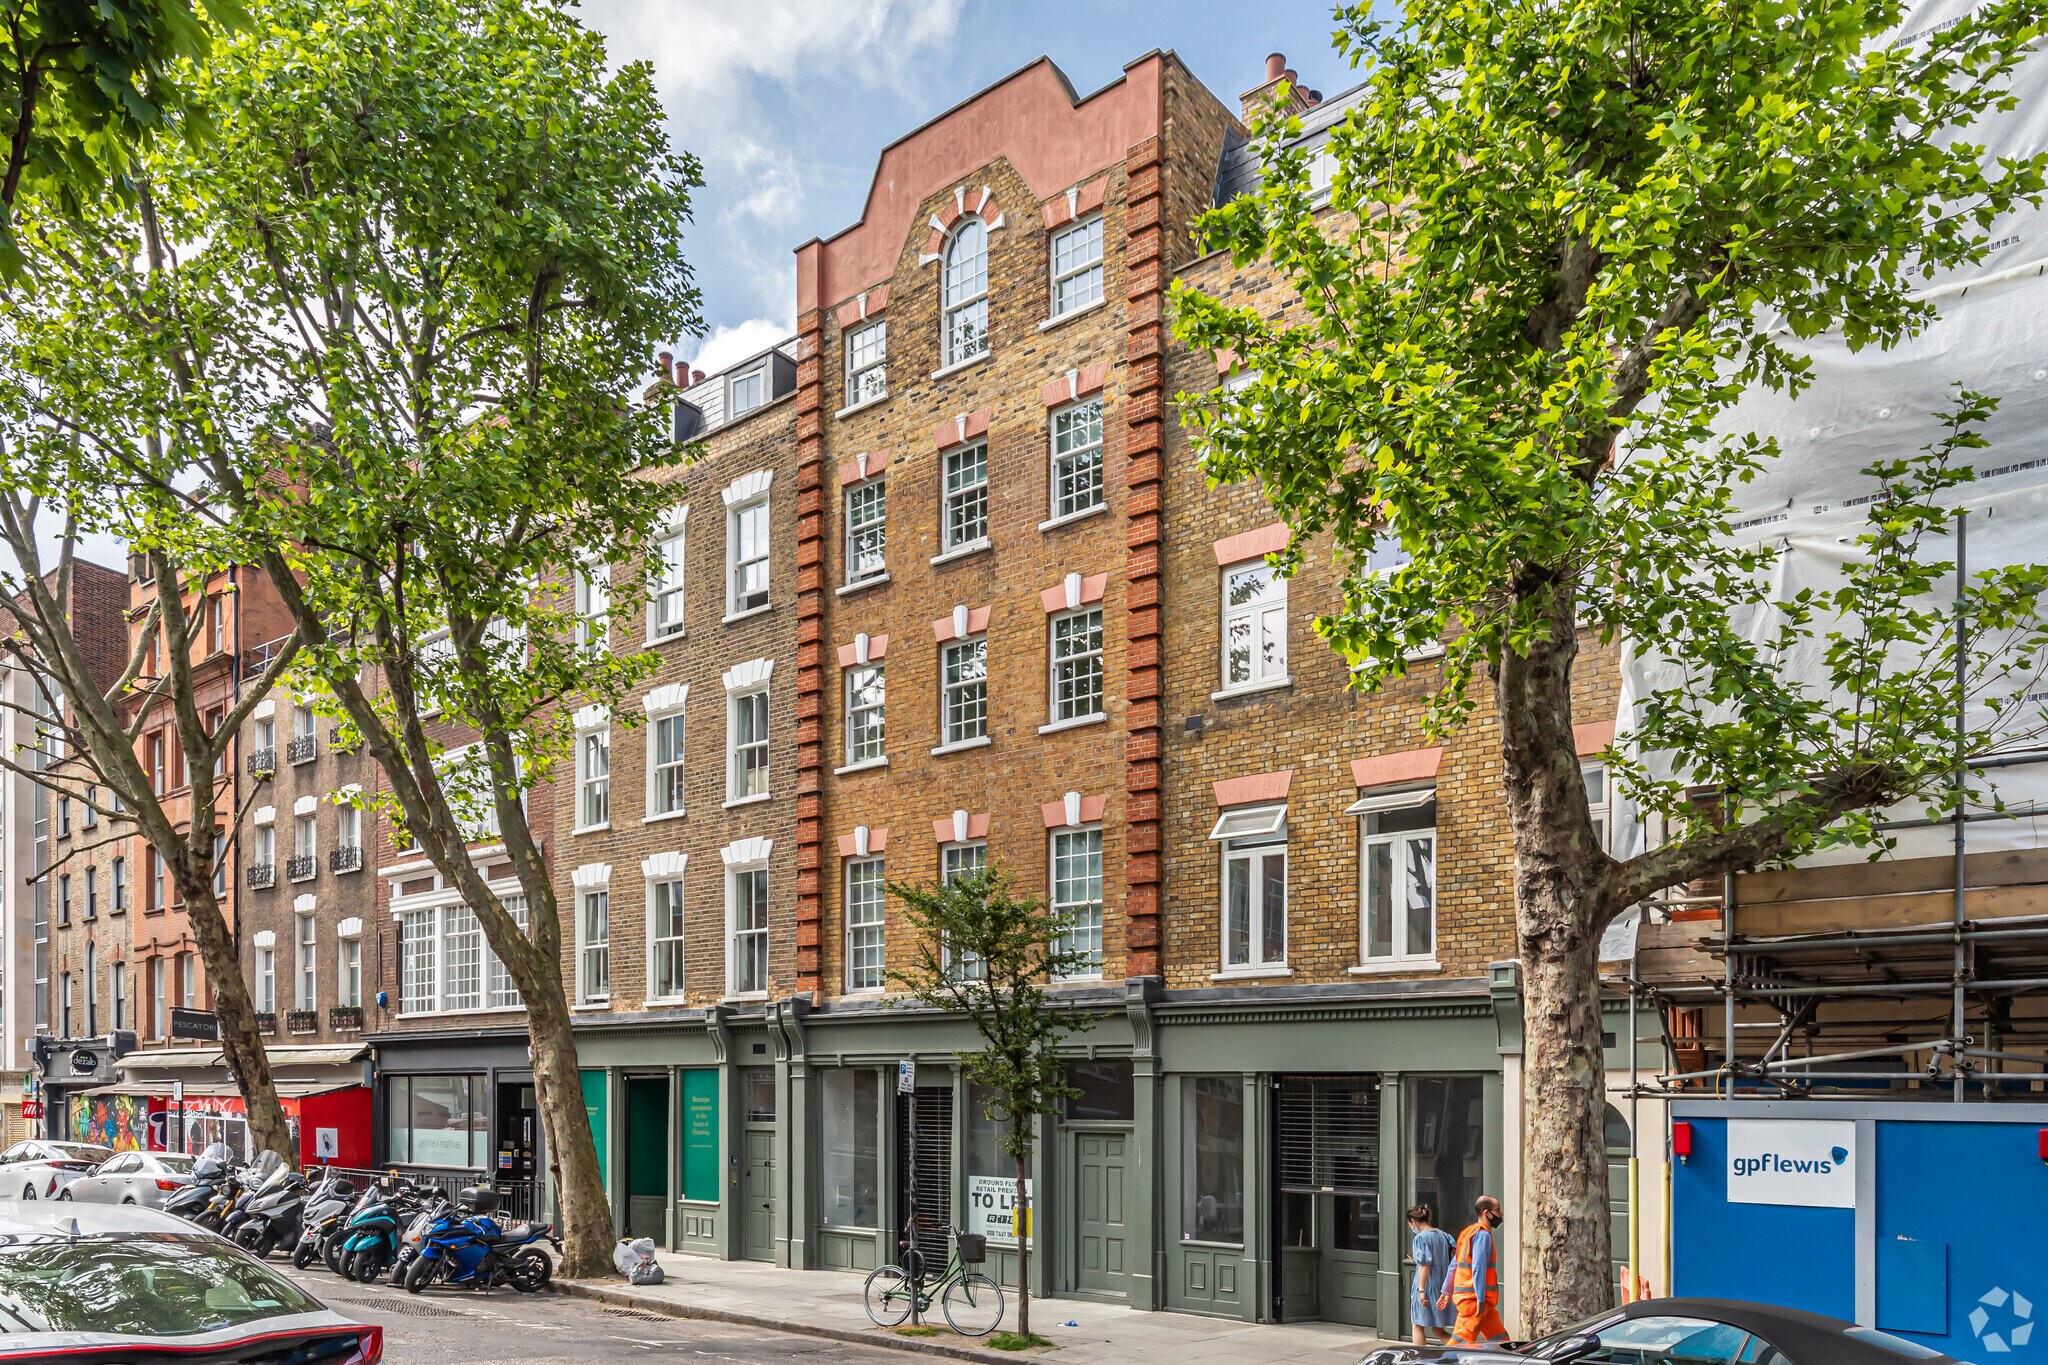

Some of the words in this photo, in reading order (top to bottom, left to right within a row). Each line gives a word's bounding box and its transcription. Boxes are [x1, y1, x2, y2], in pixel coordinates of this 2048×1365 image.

[173, 1020, 217, 1031] PESCATORI
[24, 1103, 42, 1118] ill
[972, 1192, 994, 1208] TO
